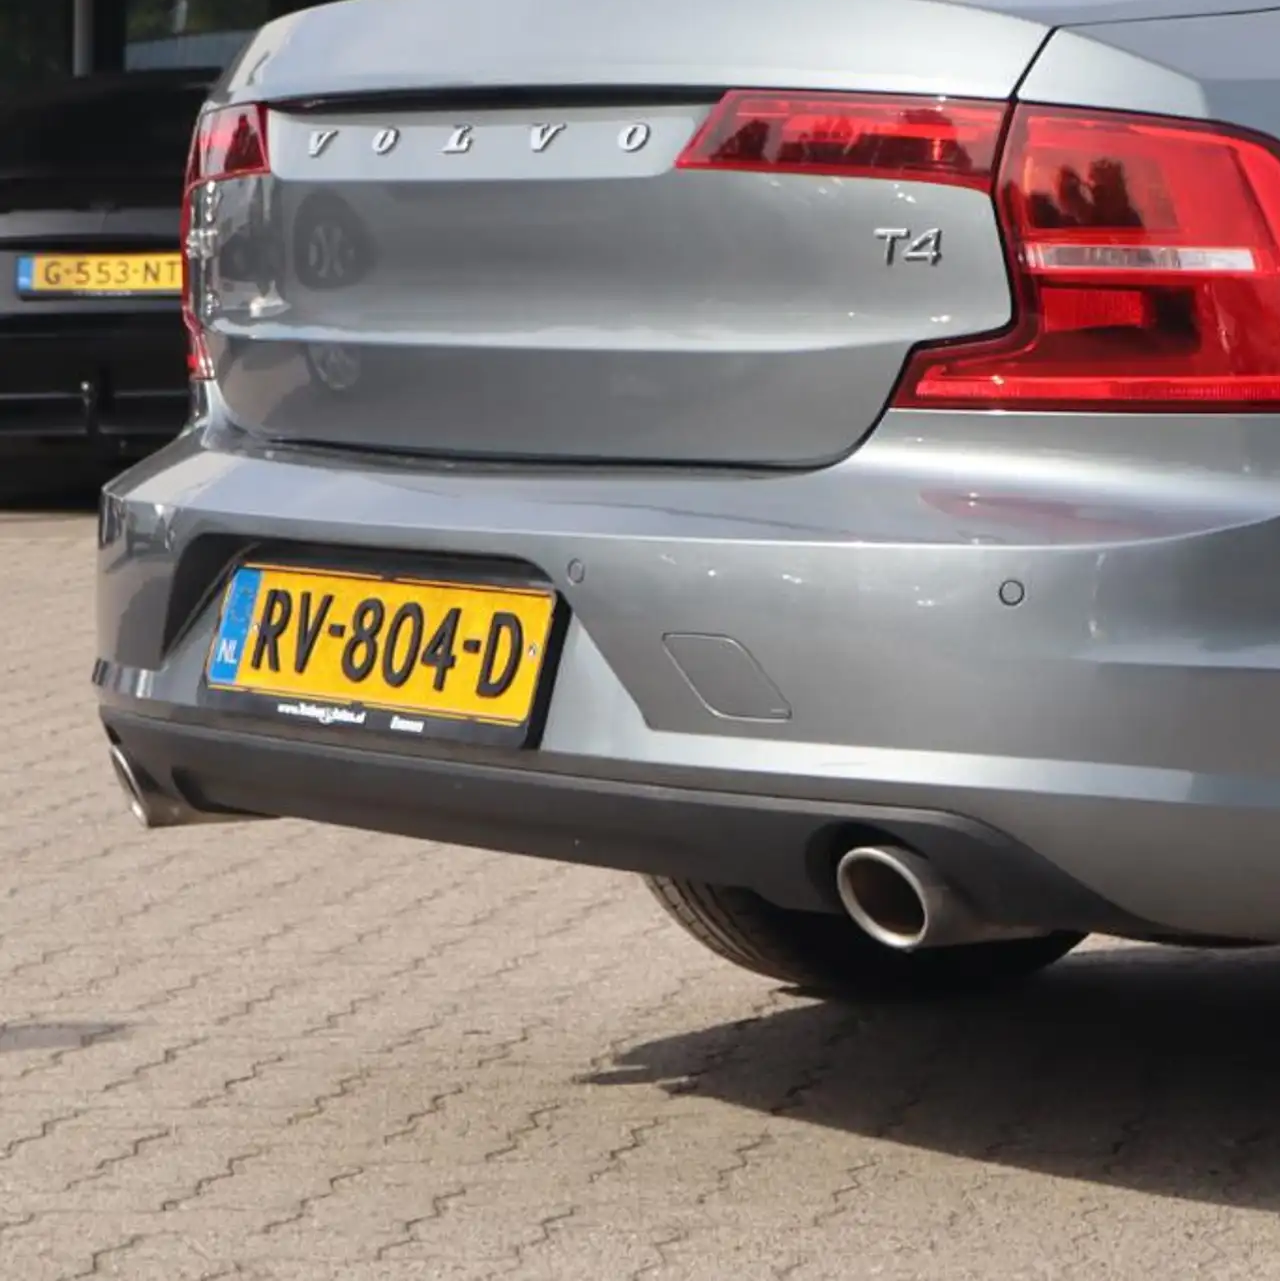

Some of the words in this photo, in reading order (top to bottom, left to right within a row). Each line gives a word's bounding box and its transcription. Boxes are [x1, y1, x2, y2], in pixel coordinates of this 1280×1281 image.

[306, 122, 653, 156] VOLVO
[873, 226, 943, 267] T4
[216, 637, 239, 665] NL
[250, 588, 525, 699] RV-804-D
